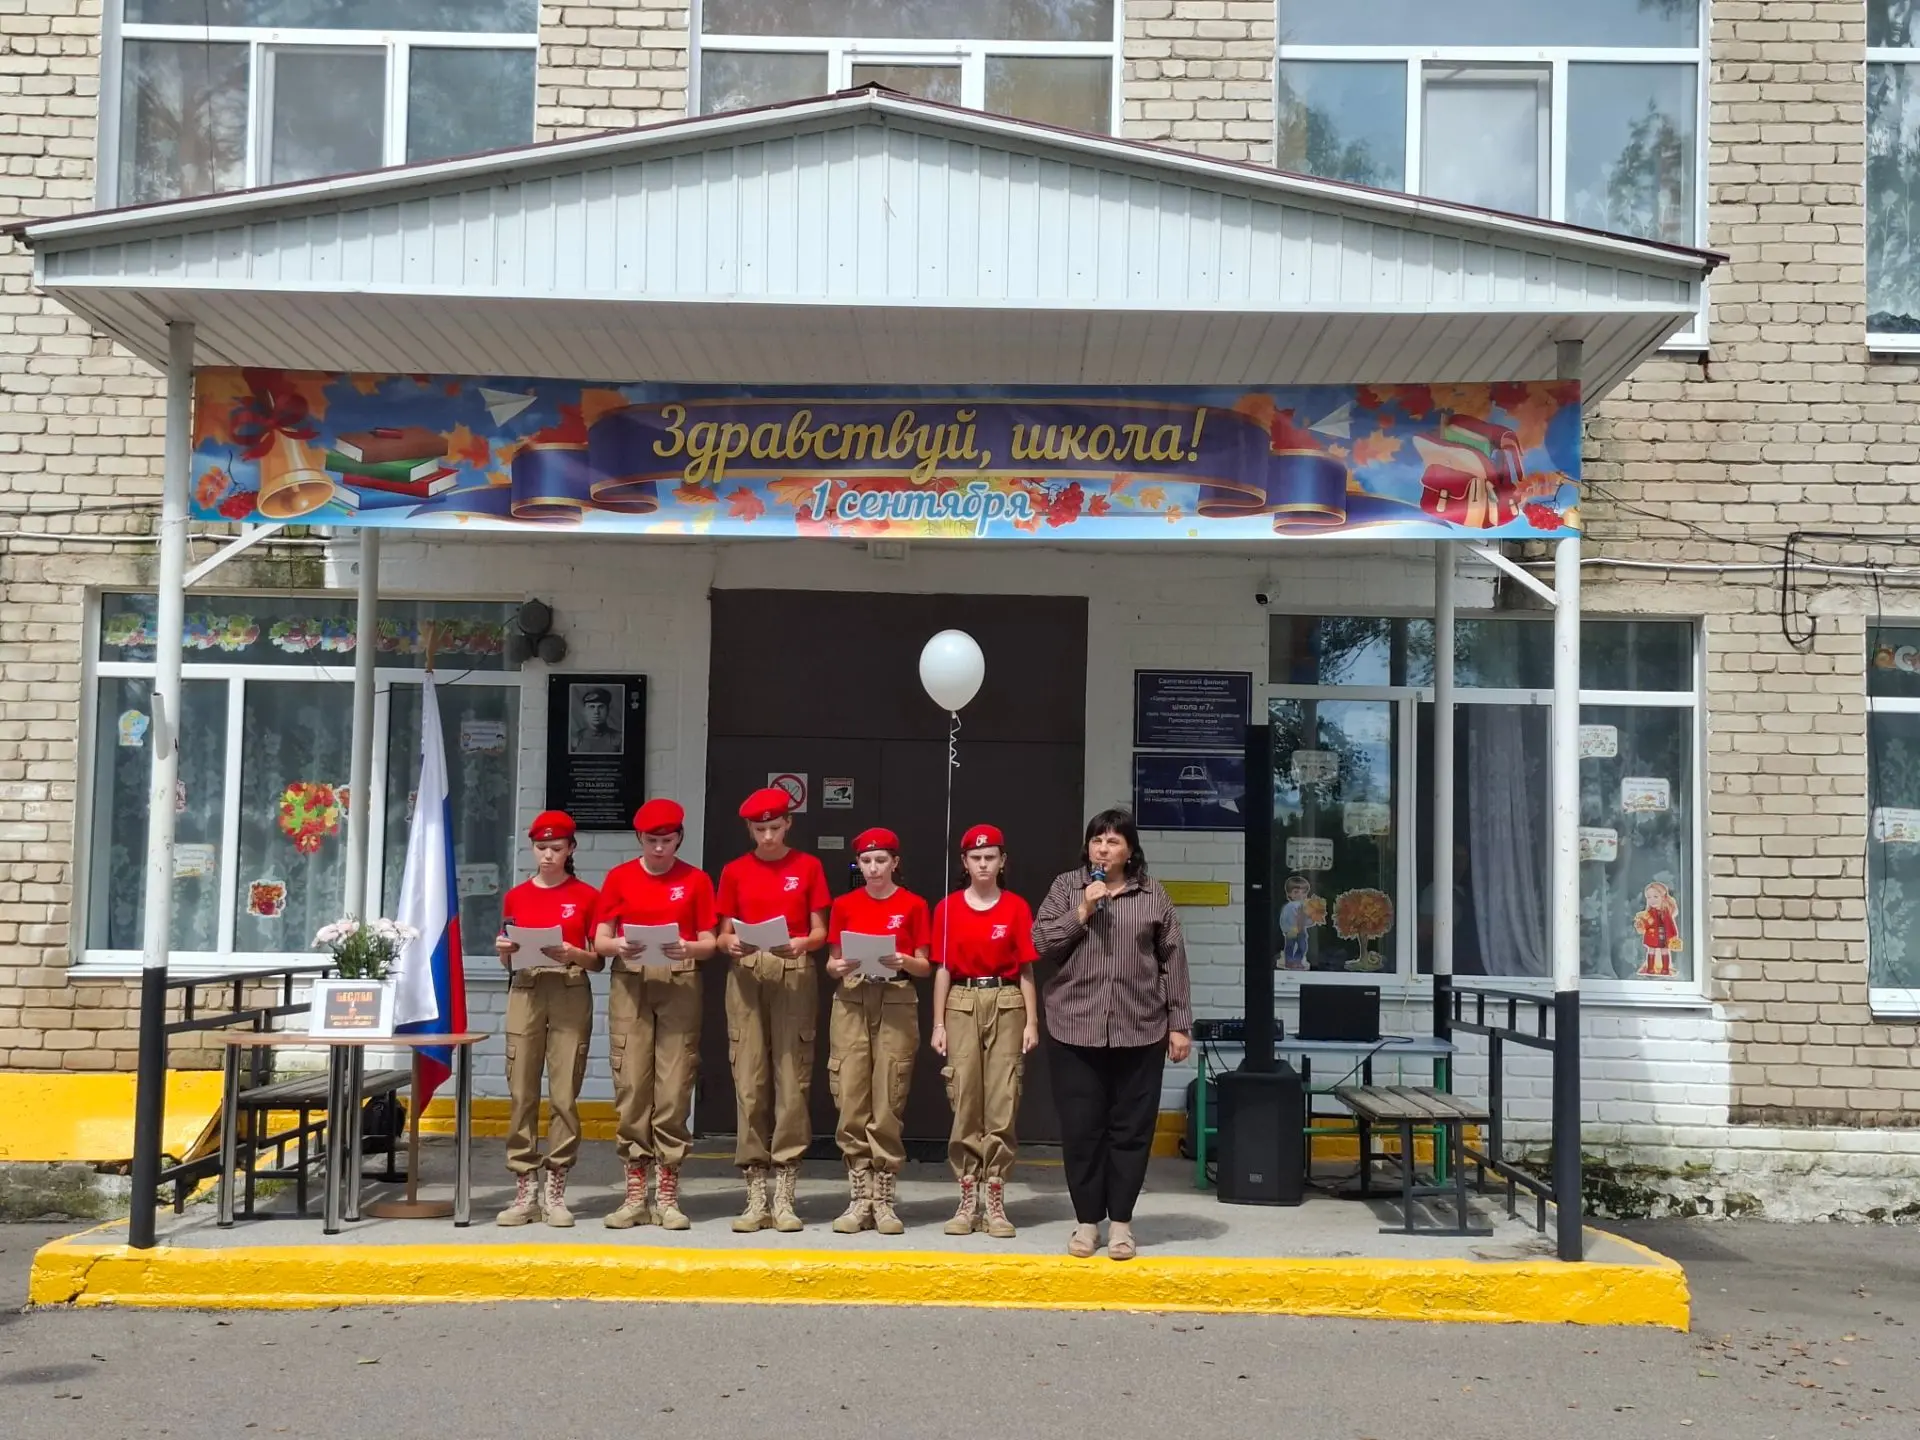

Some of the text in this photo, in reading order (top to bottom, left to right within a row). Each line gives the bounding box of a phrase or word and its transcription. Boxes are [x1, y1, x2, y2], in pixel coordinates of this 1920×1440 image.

[652, 403, 1207, 485] Здравствуй, школа!
[811, 479, 1035, 538] 1 сентября
[1171, 703, 1198, 711] школа
